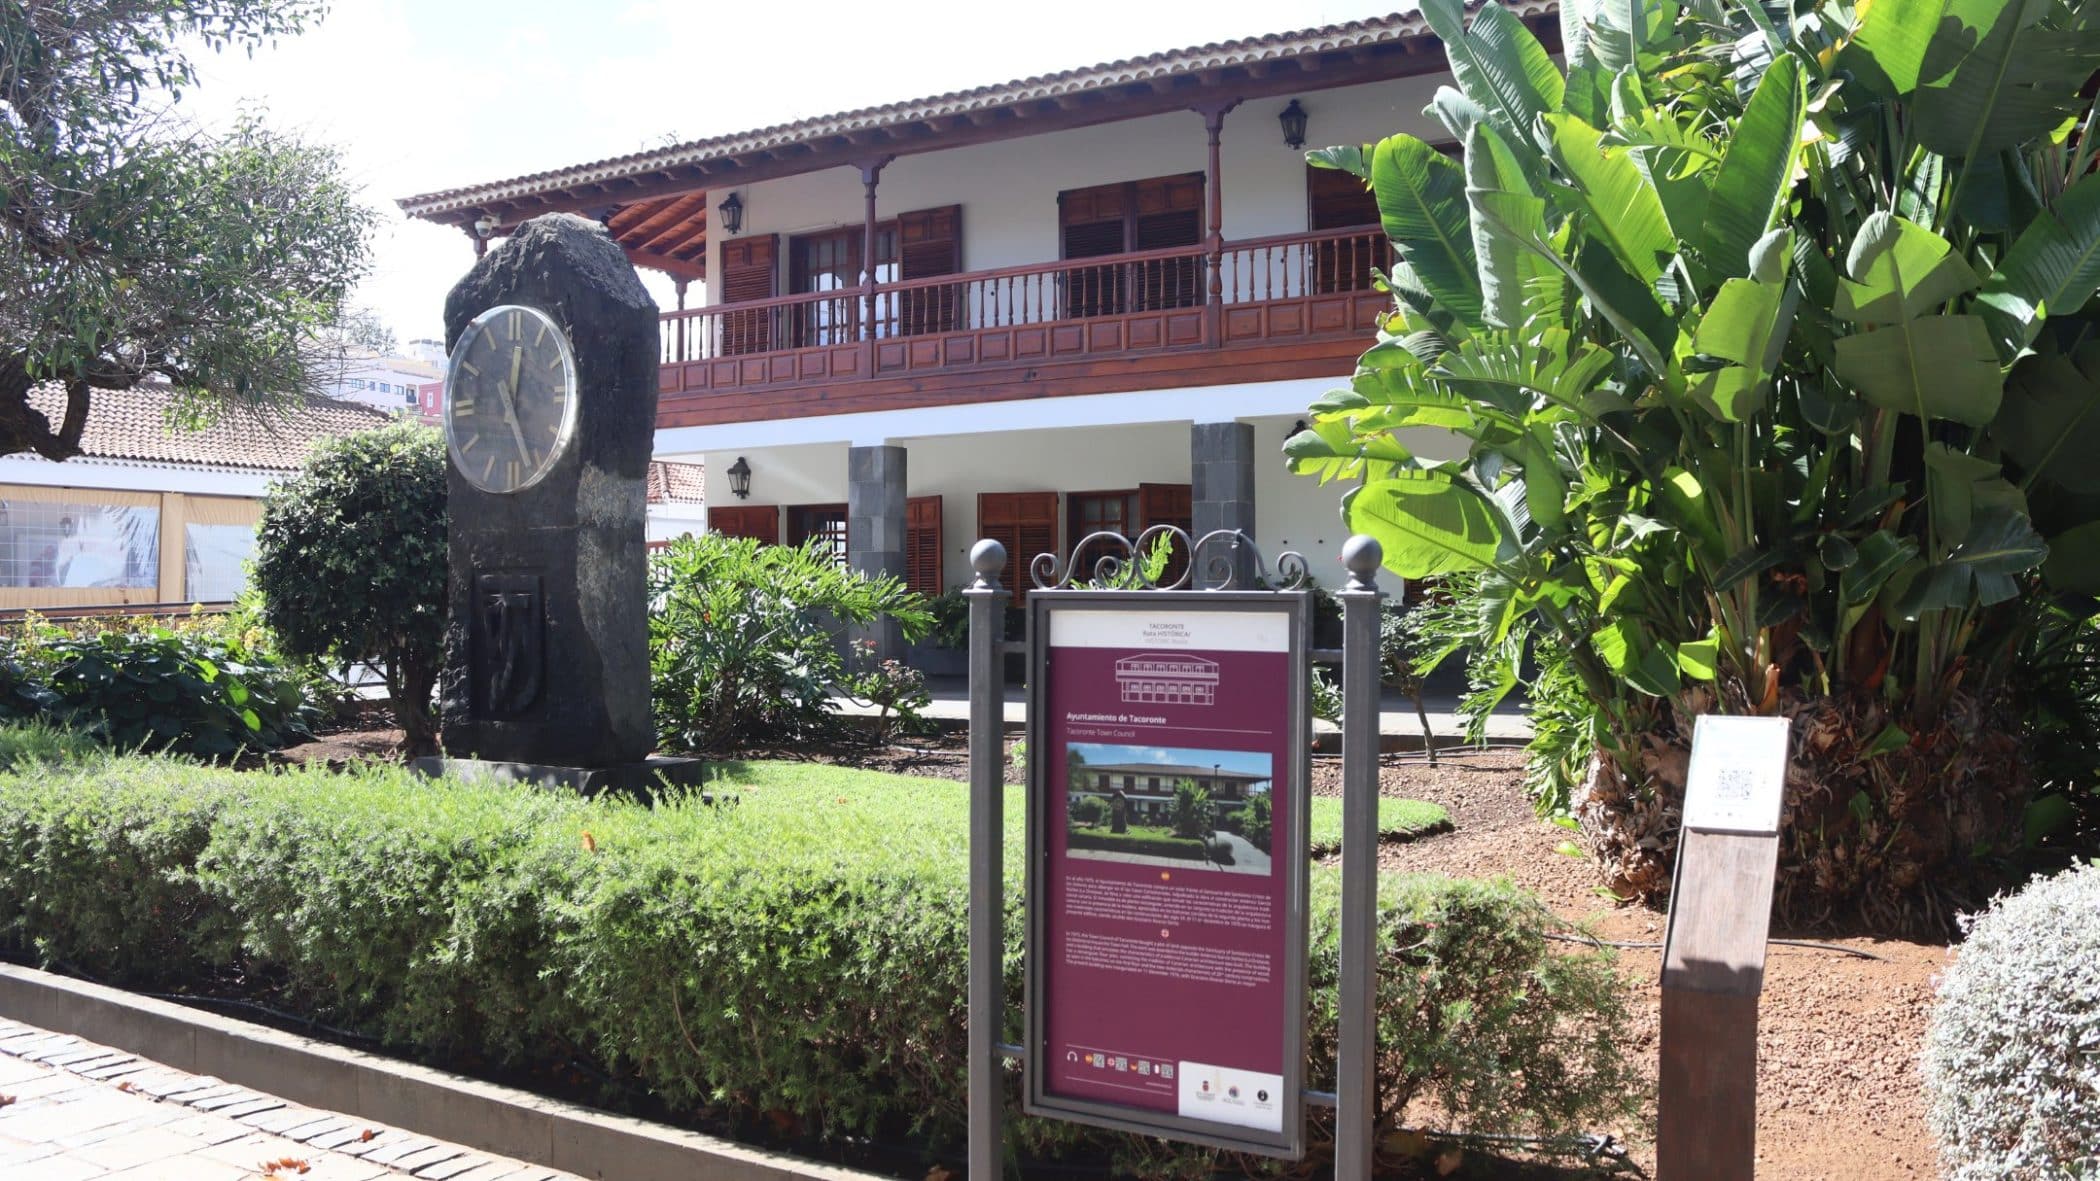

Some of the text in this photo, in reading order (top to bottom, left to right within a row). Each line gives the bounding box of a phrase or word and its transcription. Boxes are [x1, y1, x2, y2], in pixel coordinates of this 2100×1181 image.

[1066, 712, 1167, 725] Ayuntamiento de Tacoronte
[1066, 727, 1136, 738] Tacoronte Town Council
